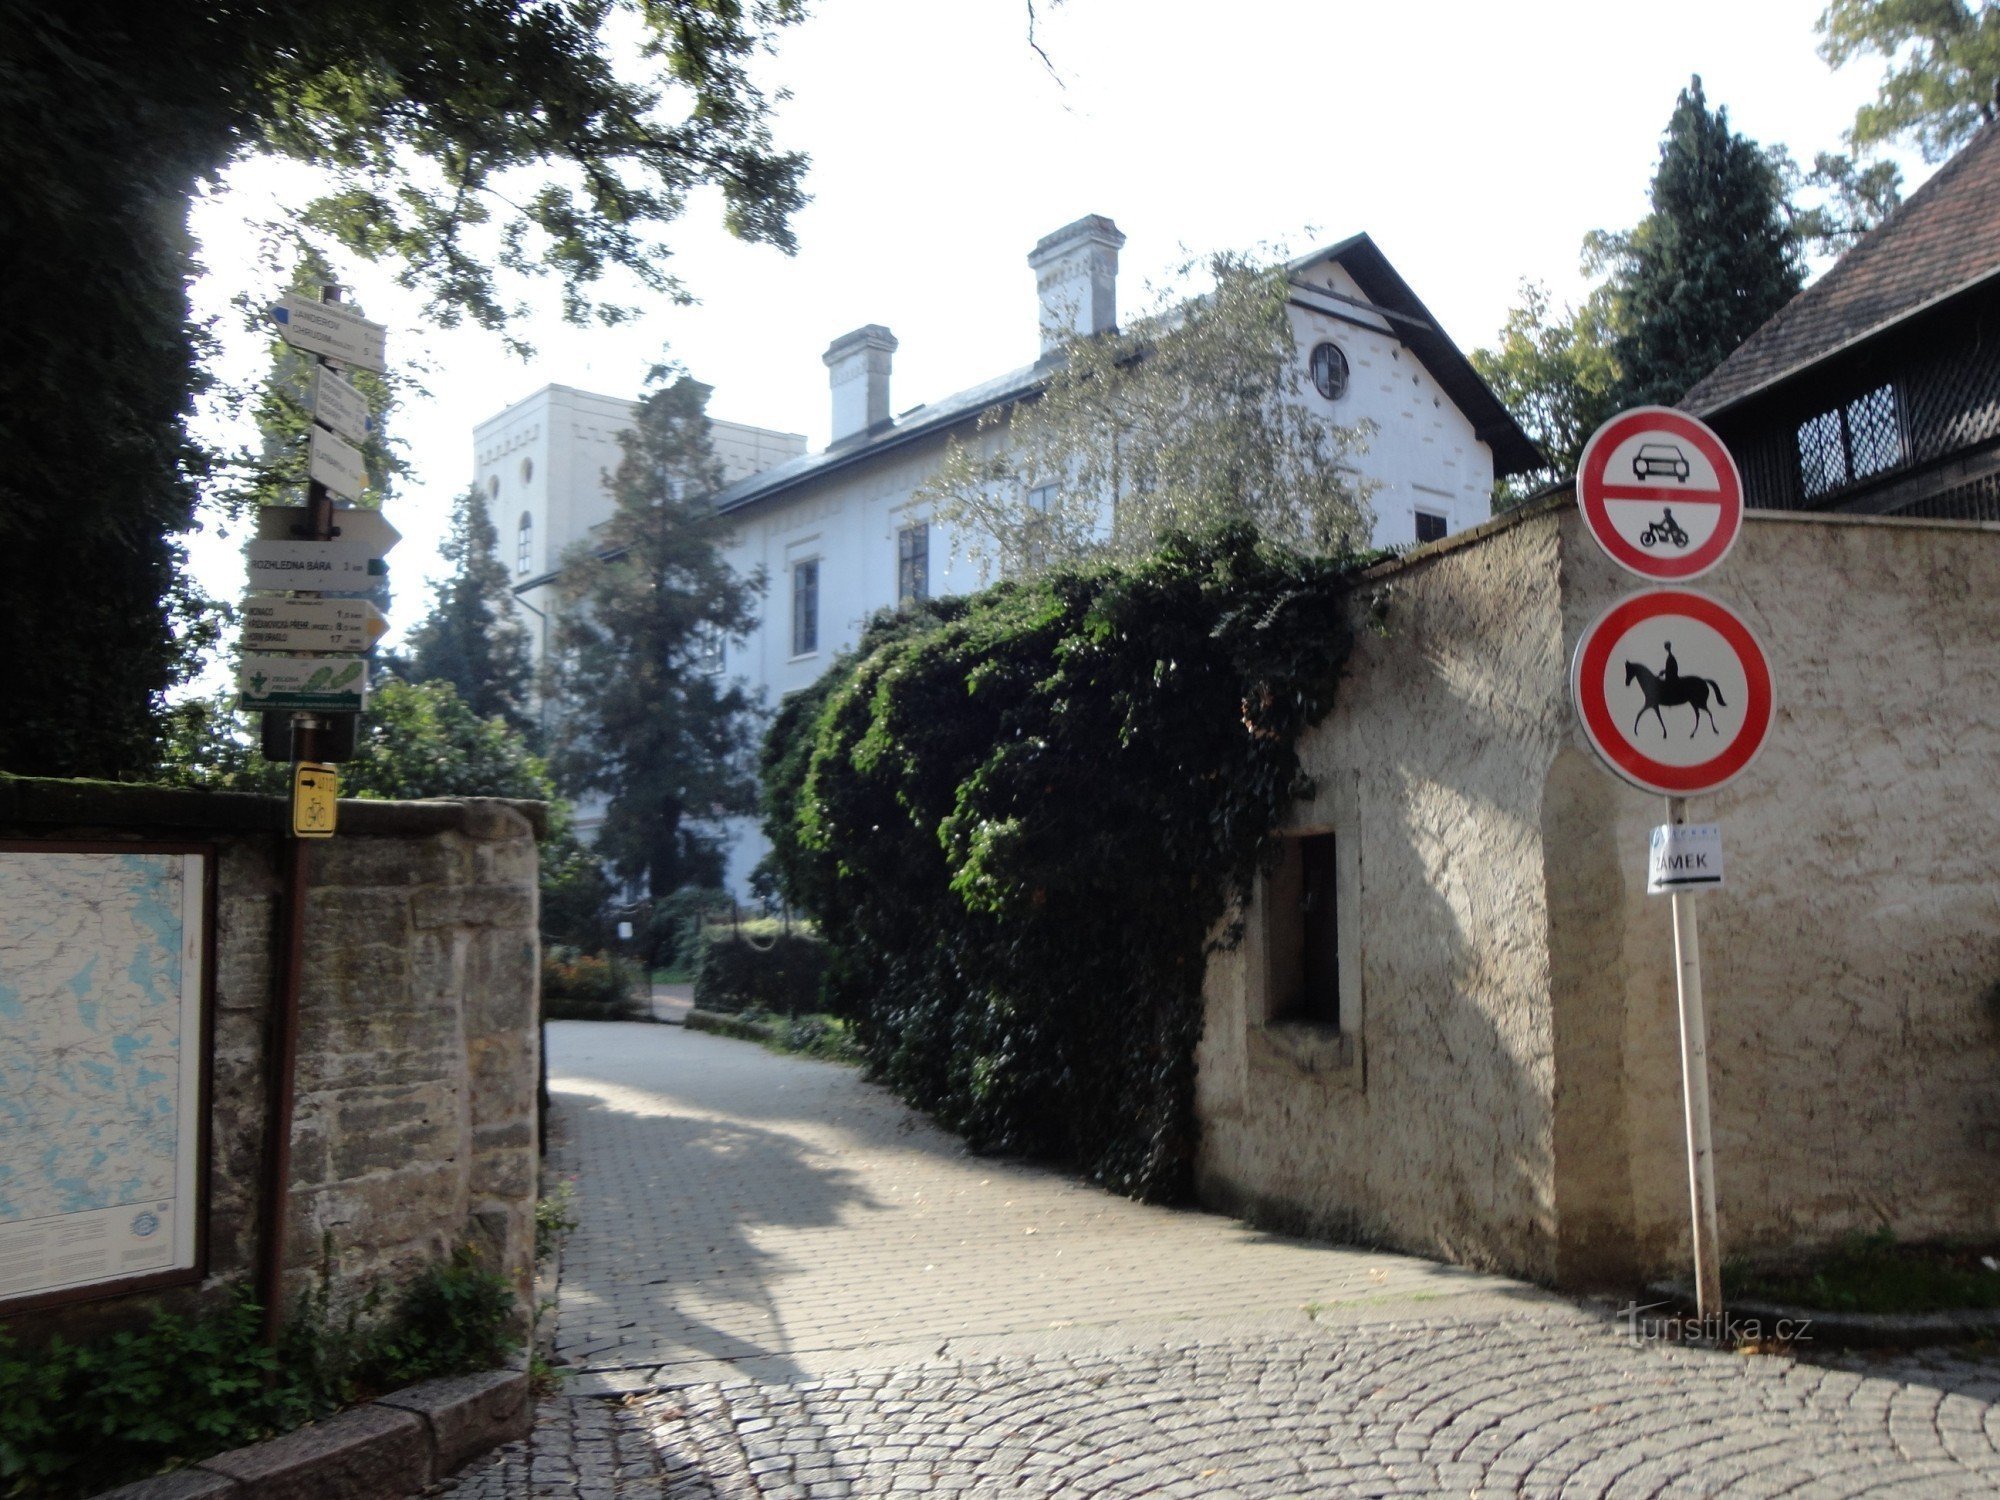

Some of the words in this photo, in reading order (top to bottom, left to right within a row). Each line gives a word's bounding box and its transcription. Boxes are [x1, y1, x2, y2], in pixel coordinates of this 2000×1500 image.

[292, 325, 332, 343] CHRUDIM
[251, 560, 304, 570] ROZHLEDNA
[330, 635, 343, 643] 17
